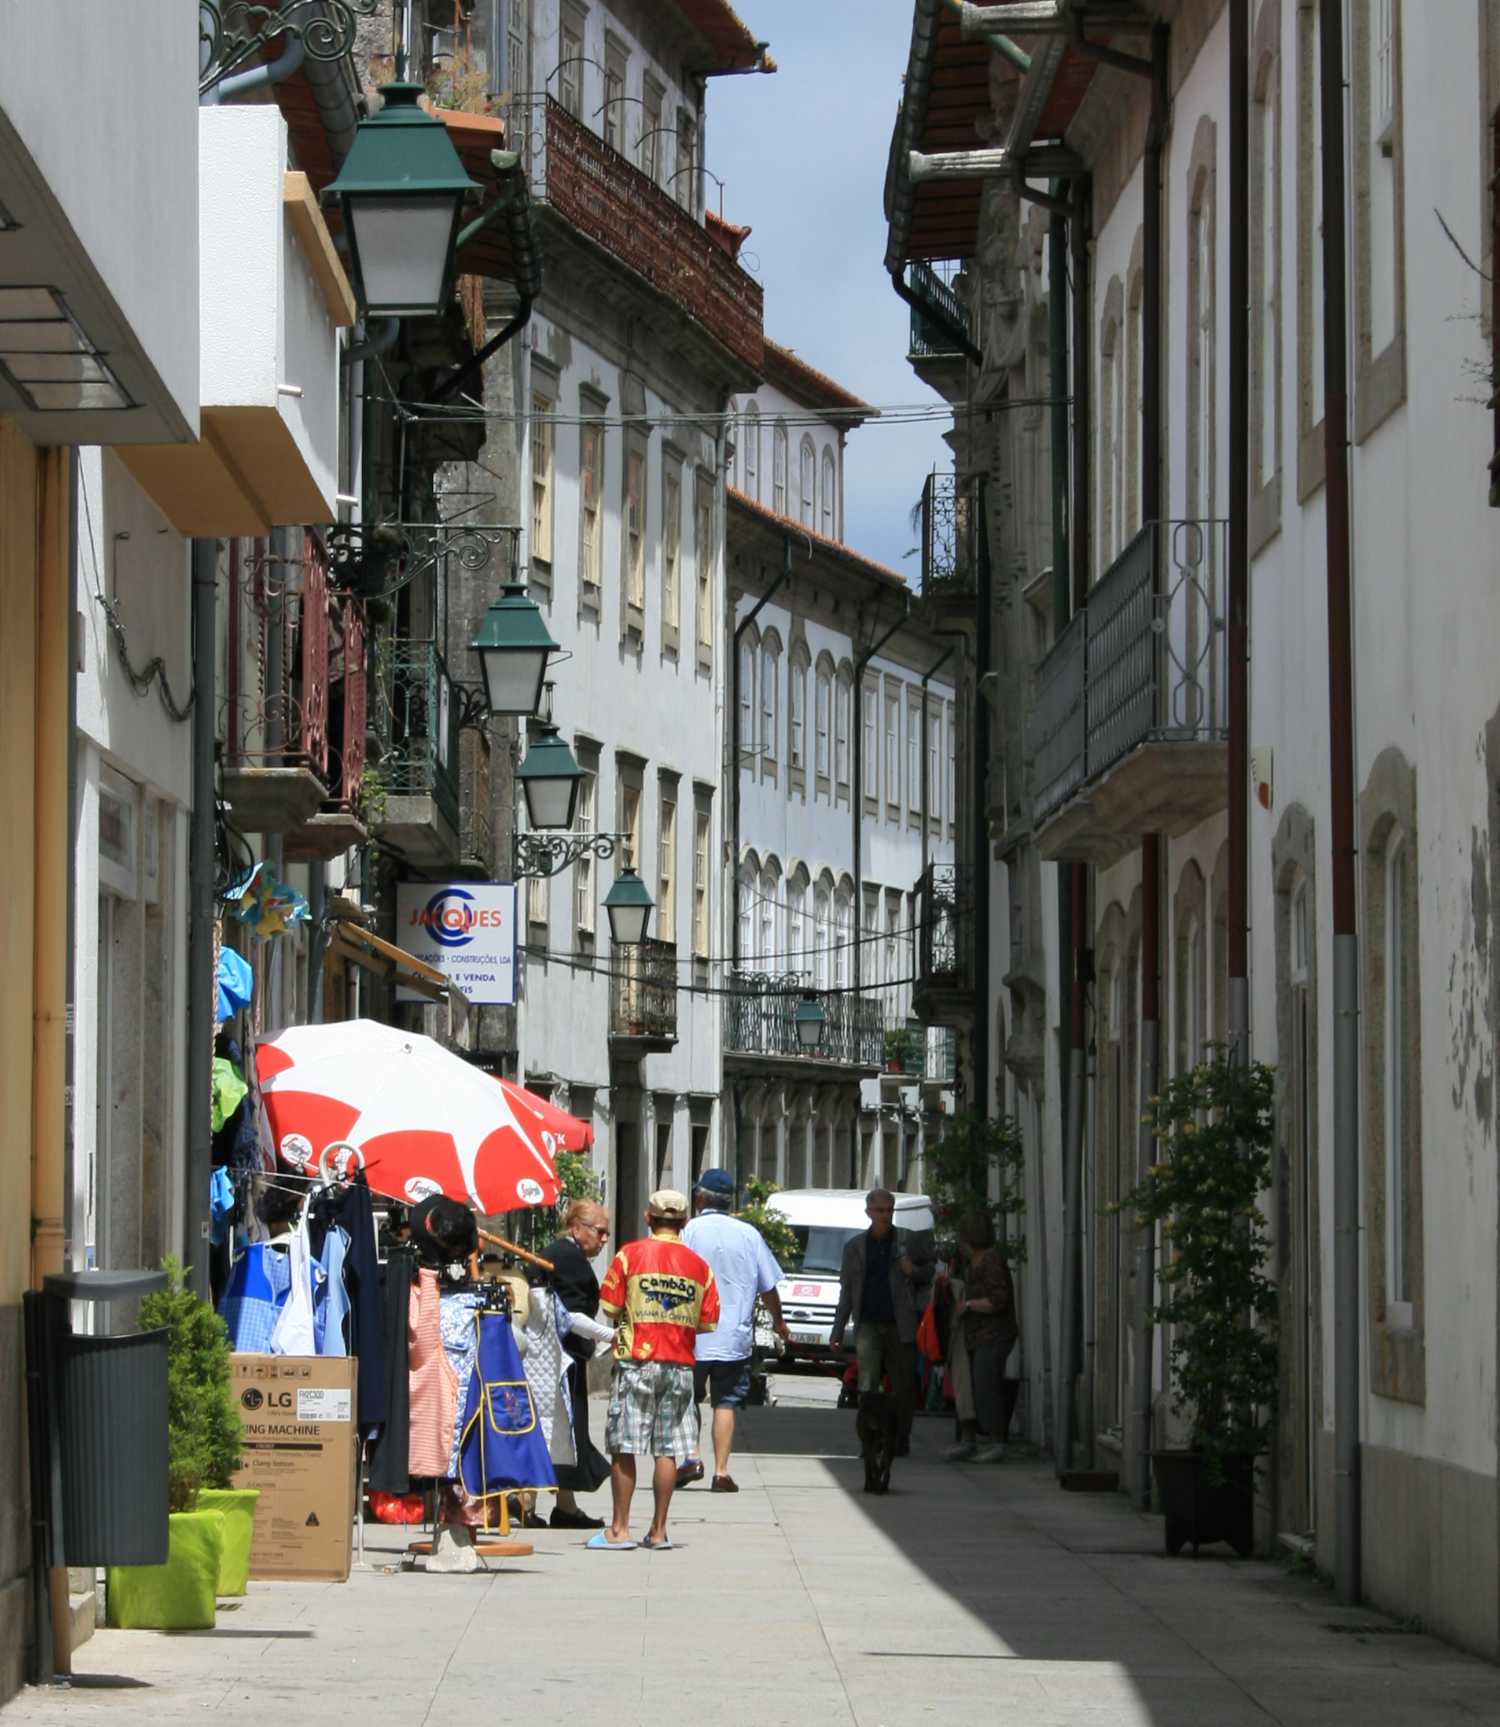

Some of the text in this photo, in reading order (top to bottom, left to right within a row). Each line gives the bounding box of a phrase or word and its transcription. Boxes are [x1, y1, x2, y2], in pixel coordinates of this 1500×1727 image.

[455, 973, 460, 981] E
[464, 973, 496, 982] VENDA
[267, 1392, 292, 1408] LG
[246, 1424, 320, 1436] ING MACHINE
